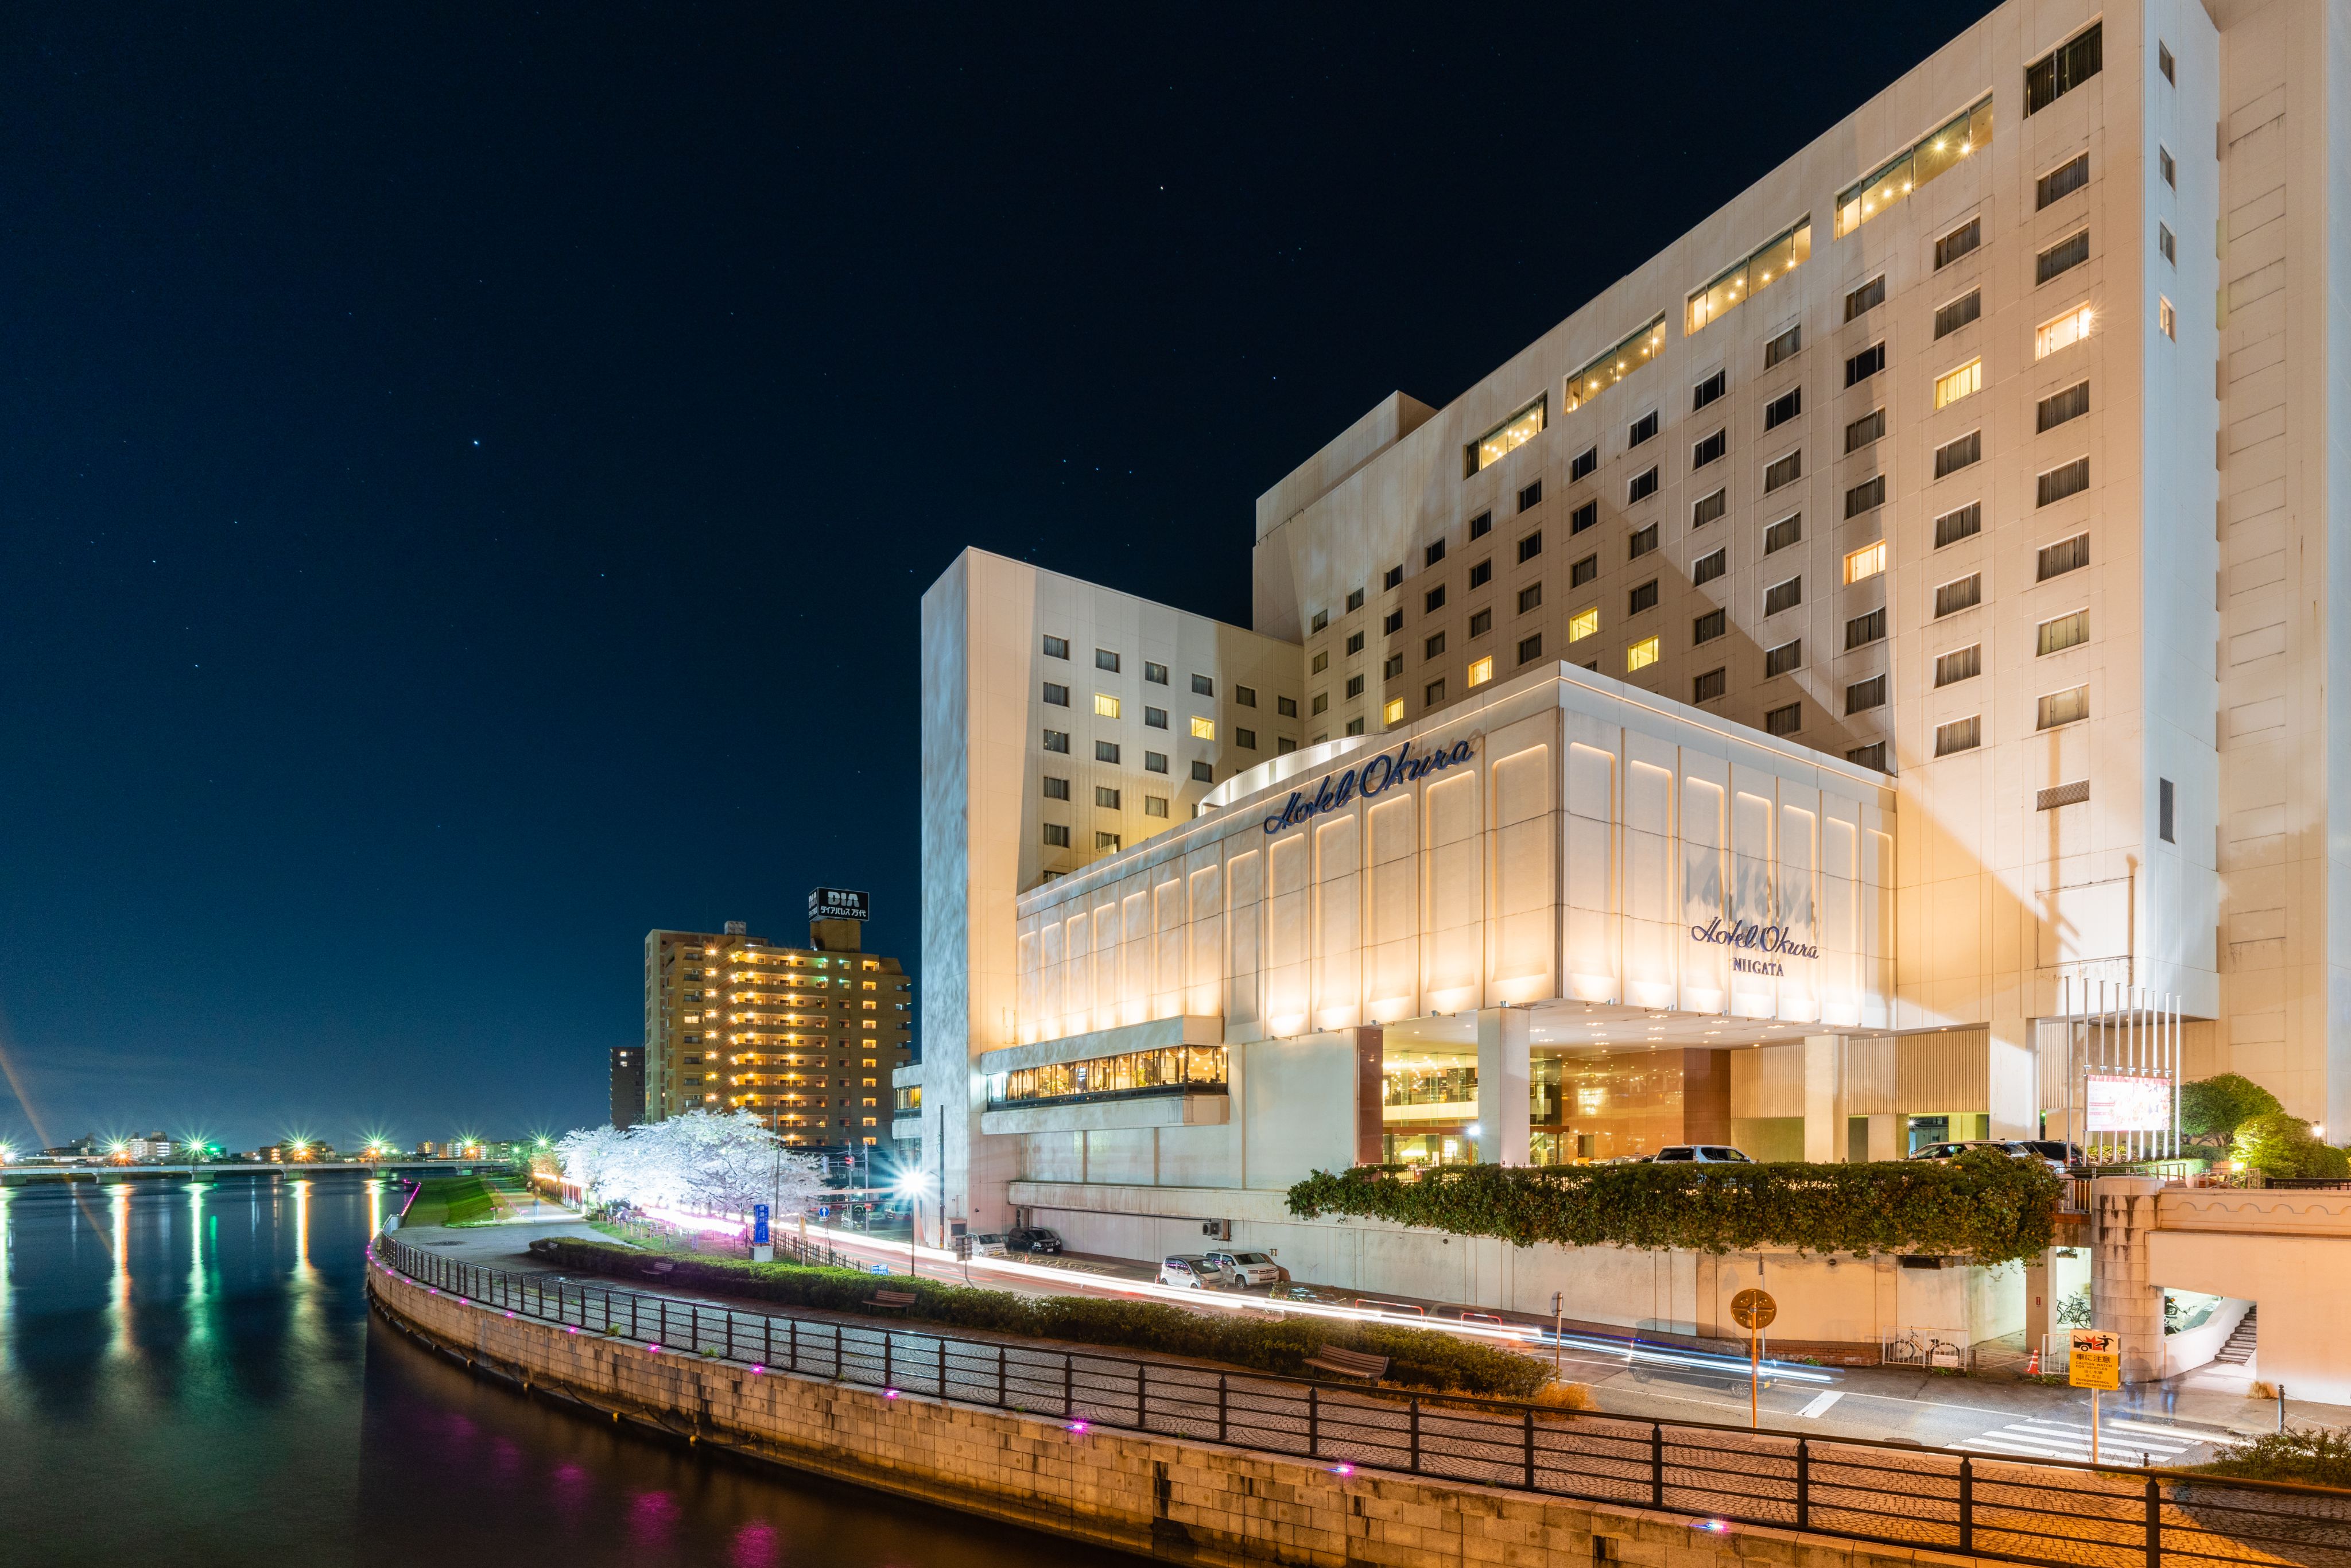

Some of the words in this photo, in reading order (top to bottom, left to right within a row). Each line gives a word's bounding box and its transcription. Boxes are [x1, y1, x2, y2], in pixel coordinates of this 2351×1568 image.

[1263, 769, 1355, 835] Hotel
[1359, 740, 1474, 798] Okura
[828, 891, 859, 907] DIA
[1691, 917, 1759, 949] Hotel
[1760, 926, 1819, 959] Okura
[1732, 957, 1784, 976] NIIGATA
[2075, 1353, 2111, 1363] 車に注意
